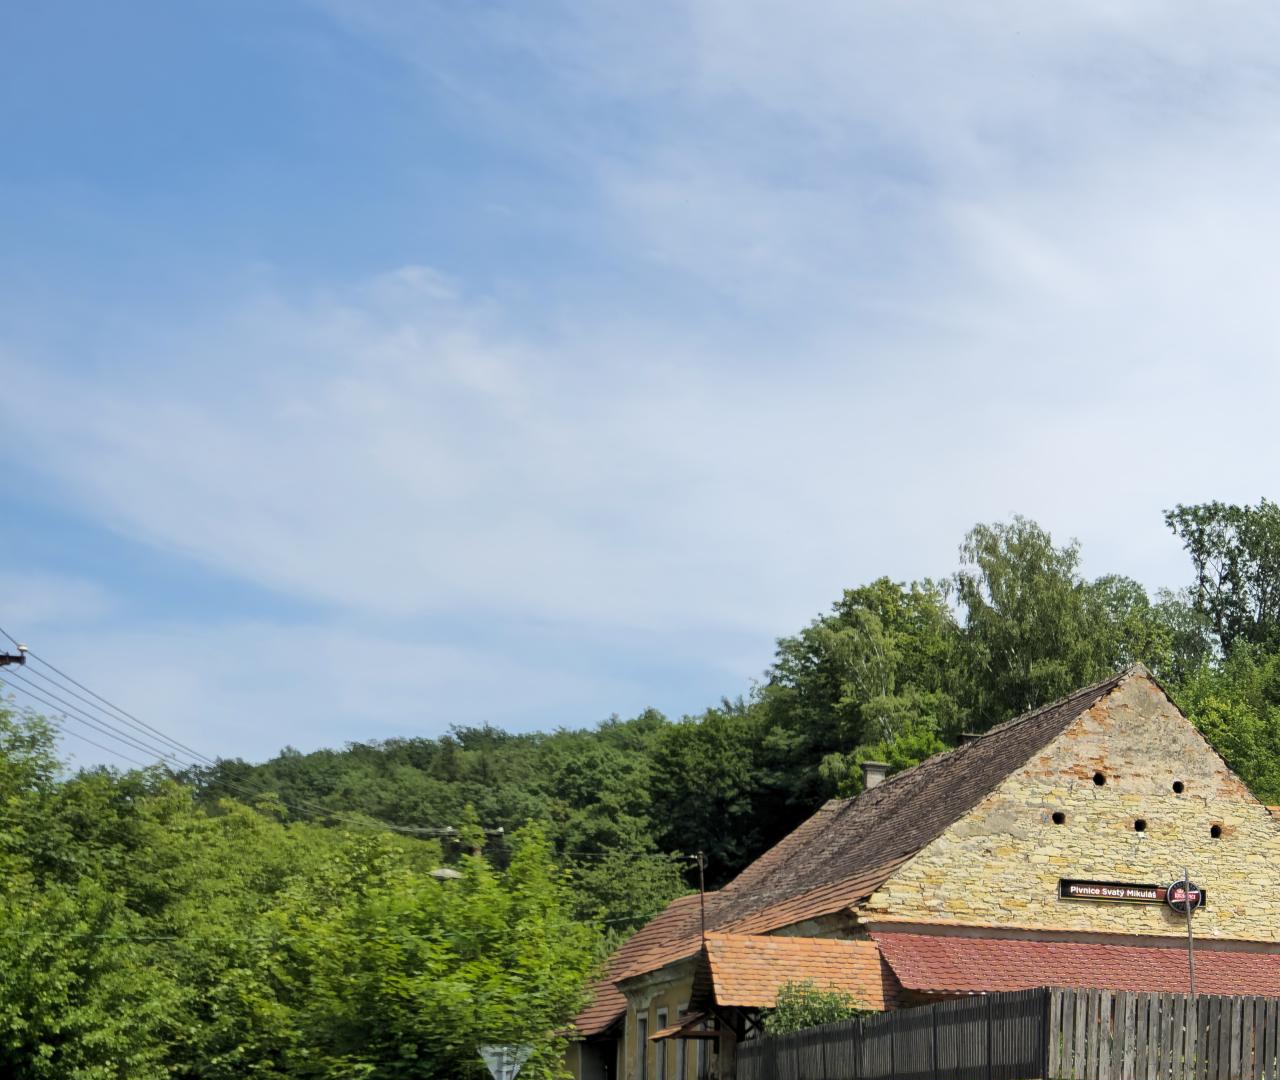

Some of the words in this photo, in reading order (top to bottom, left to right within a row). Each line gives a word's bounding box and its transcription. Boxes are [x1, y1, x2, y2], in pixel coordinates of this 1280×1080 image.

[1070, 886, 1100, 895] Pivnice
[1102, 888, 1124, 898] Svatý
[1126, 889, 1157, 899] Mikuláš
